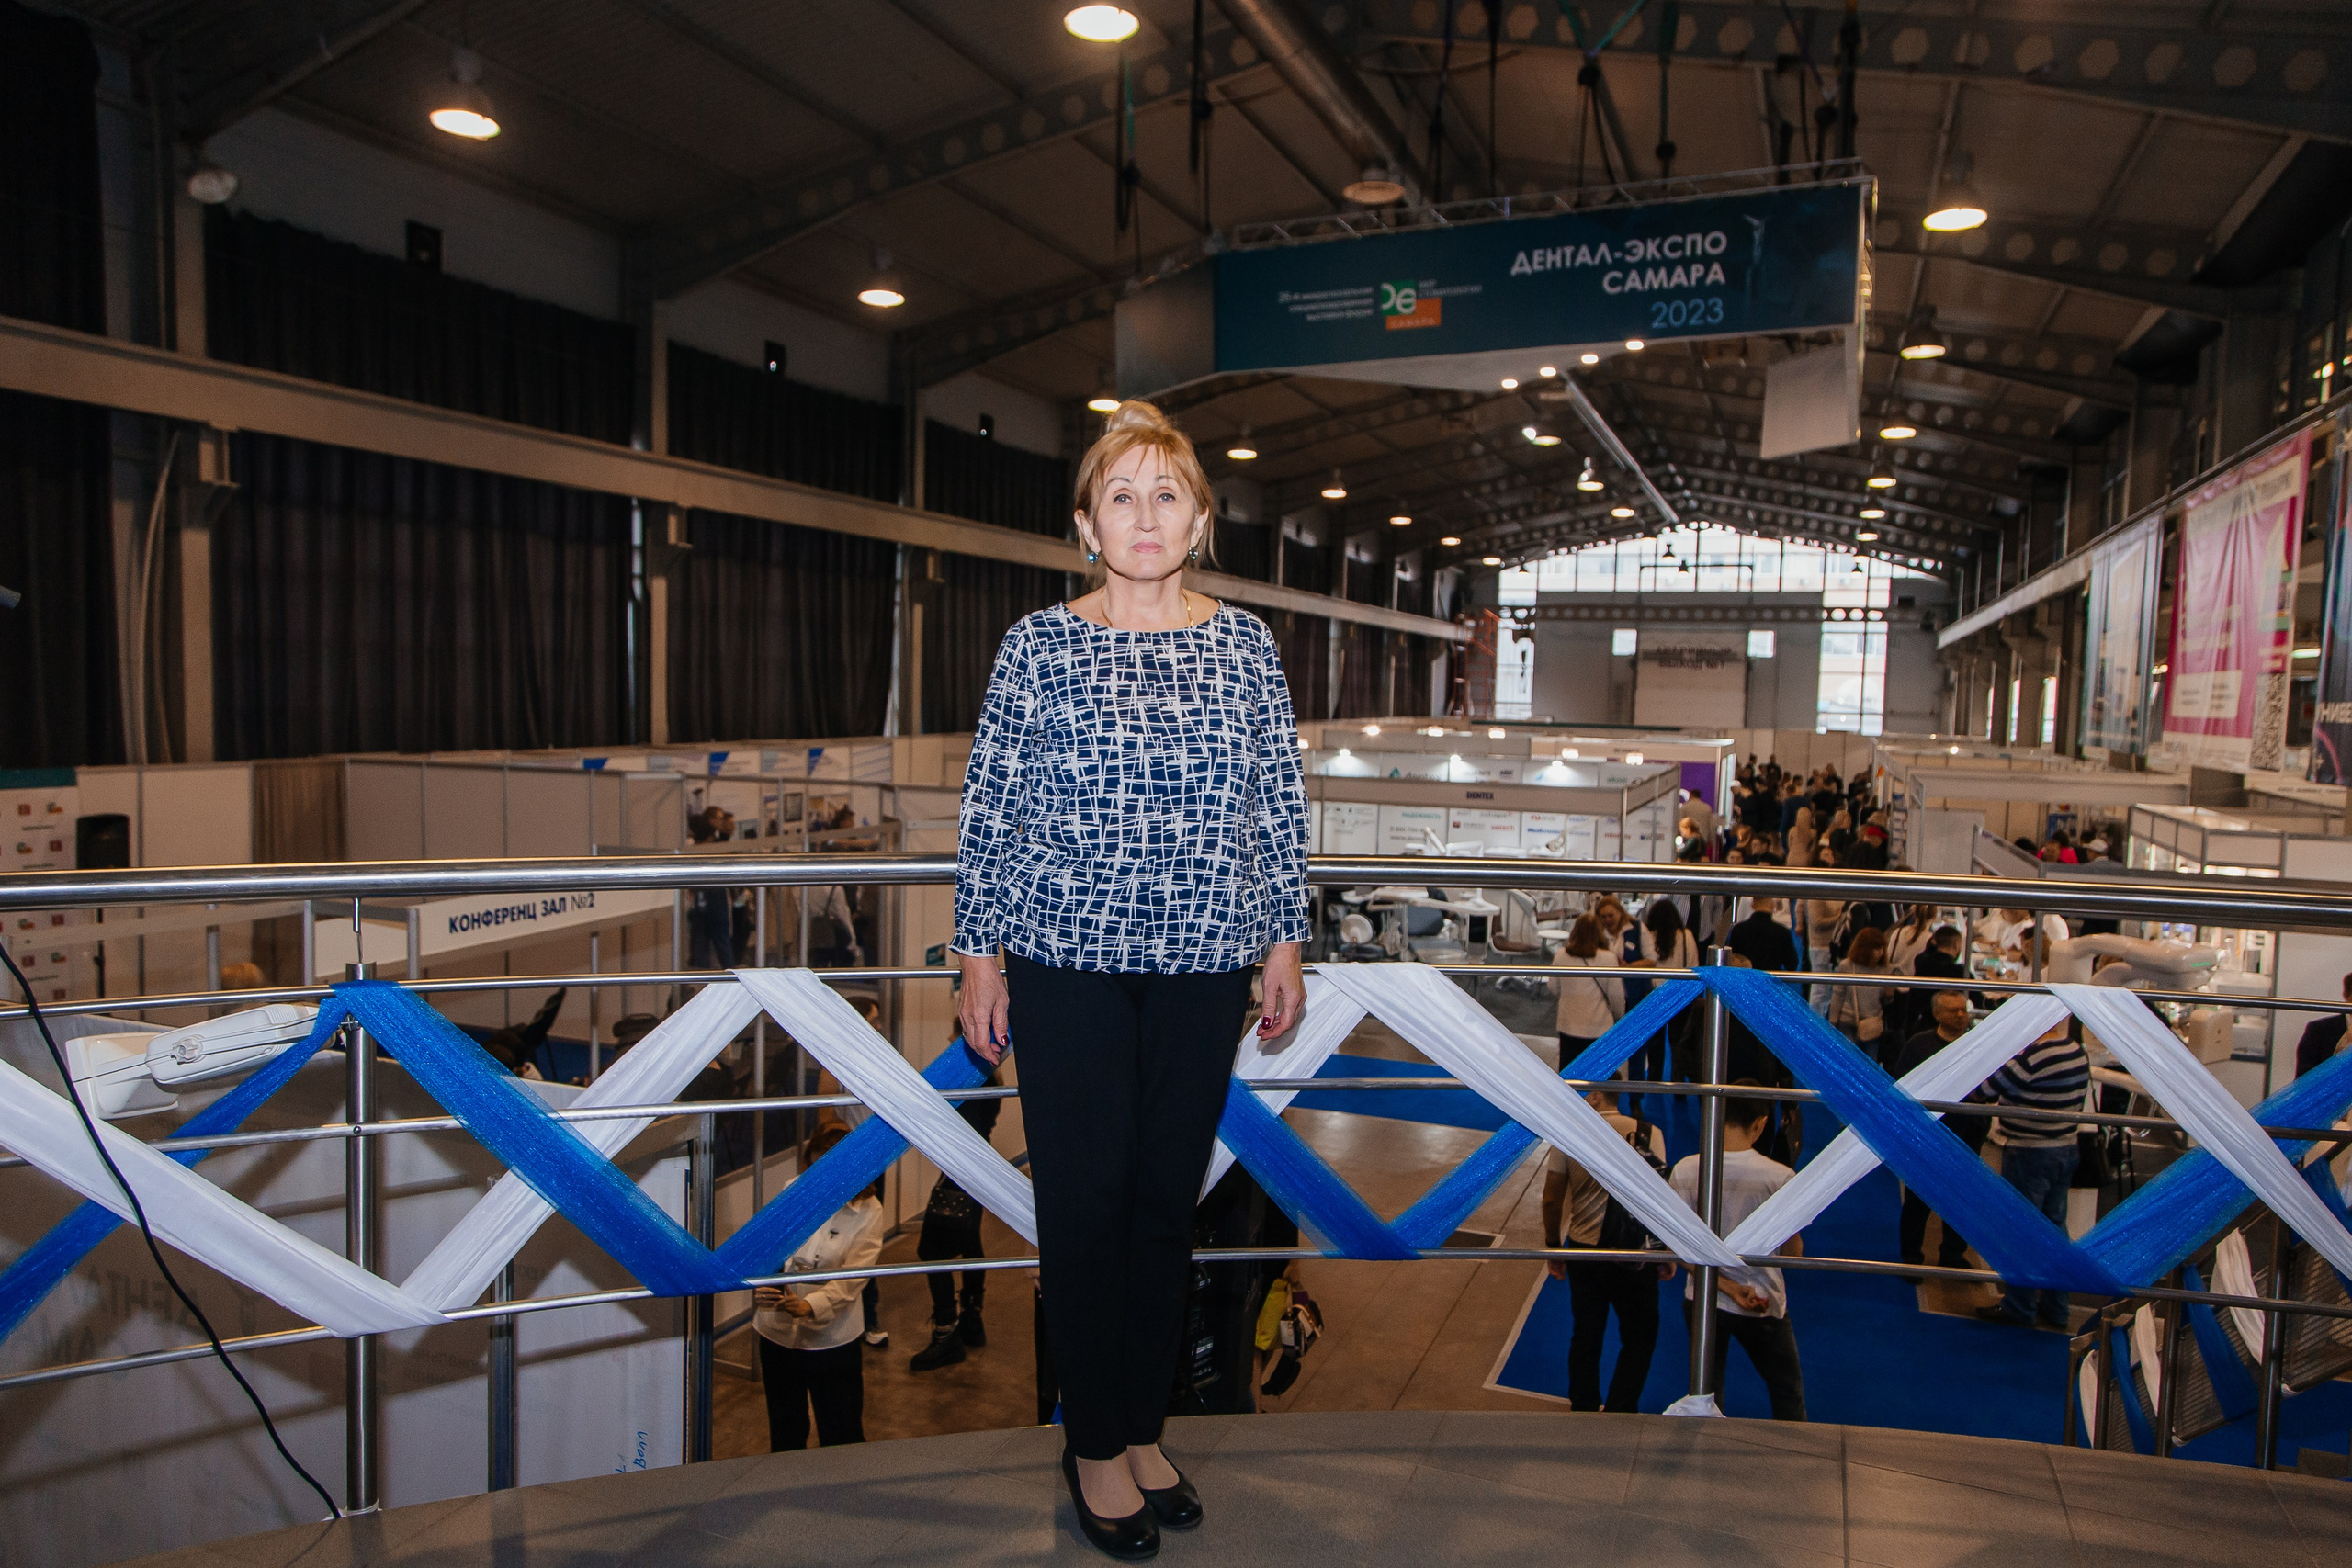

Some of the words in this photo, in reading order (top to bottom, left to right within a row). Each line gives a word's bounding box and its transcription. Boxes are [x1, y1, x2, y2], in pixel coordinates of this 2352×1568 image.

[1510, 231, 1727, 276] ДЕНТАЛ-ЭКСПО
[1602, 262, 1725, 295] САМАРА
[1651, 297, 1724, 329] 2023
[1466, 791, 1495, 800] DENTEX
[448, 902, 537, 934] КОНФЕРЕНЦ
[540, 897, 567, 917] ЗАЛ
[571, 891, 595, 910] №2
